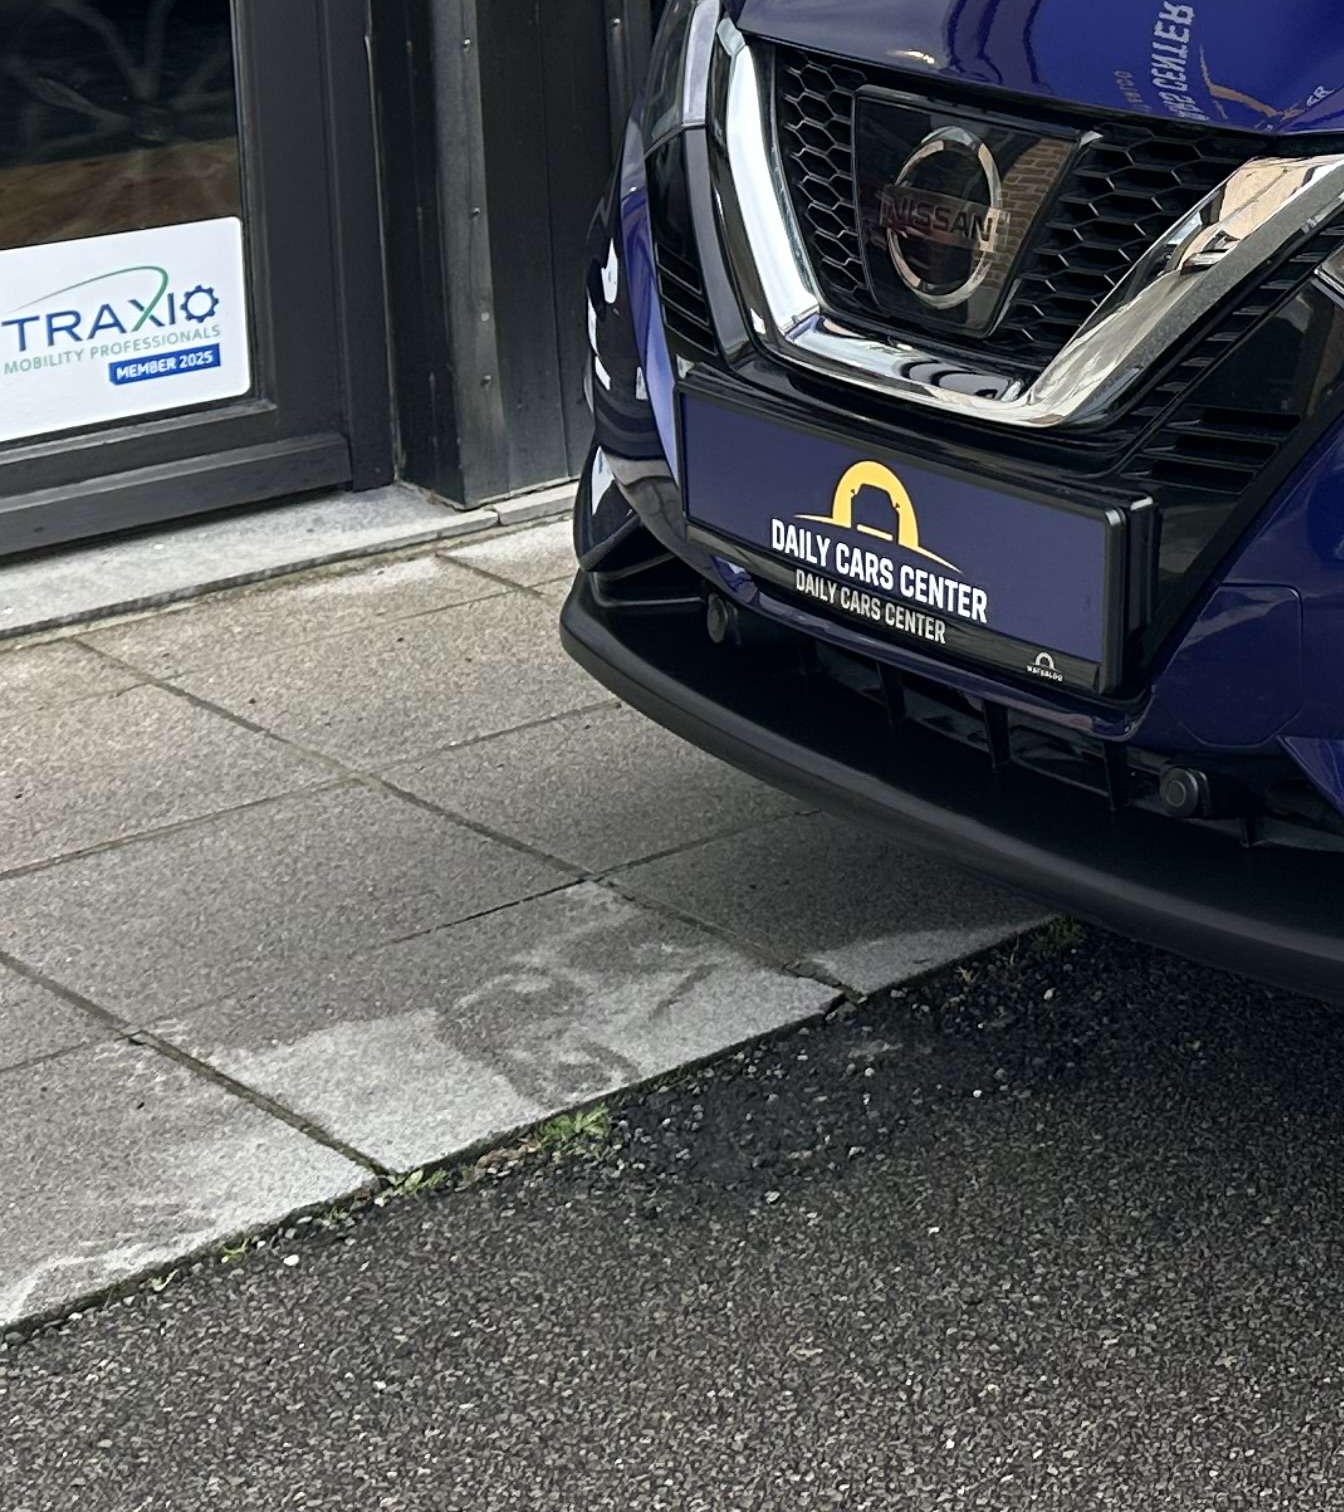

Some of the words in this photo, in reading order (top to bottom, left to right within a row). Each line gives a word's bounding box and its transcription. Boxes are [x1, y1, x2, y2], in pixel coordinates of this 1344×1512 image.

[885, 194, 995, 244] NISSAN
[1, 284, 220, 353] TRAXIO
[4, 347, 85, 375] MOBILITY
[90, 324, 222, 360] PROFESSIONALS
[116, 357, 177, 381] MEMBER
[179, 350, 214, 370] 2025
[771, 518, 831, 568] DAILY
[835, 542, 895, 591] CARS
[899, 564, 988, 624] CENTER
[795, 569, 838, 604] DAILY
[840, 586, 881, 621] CARS
[884, 602, 946, 644] CENTER
